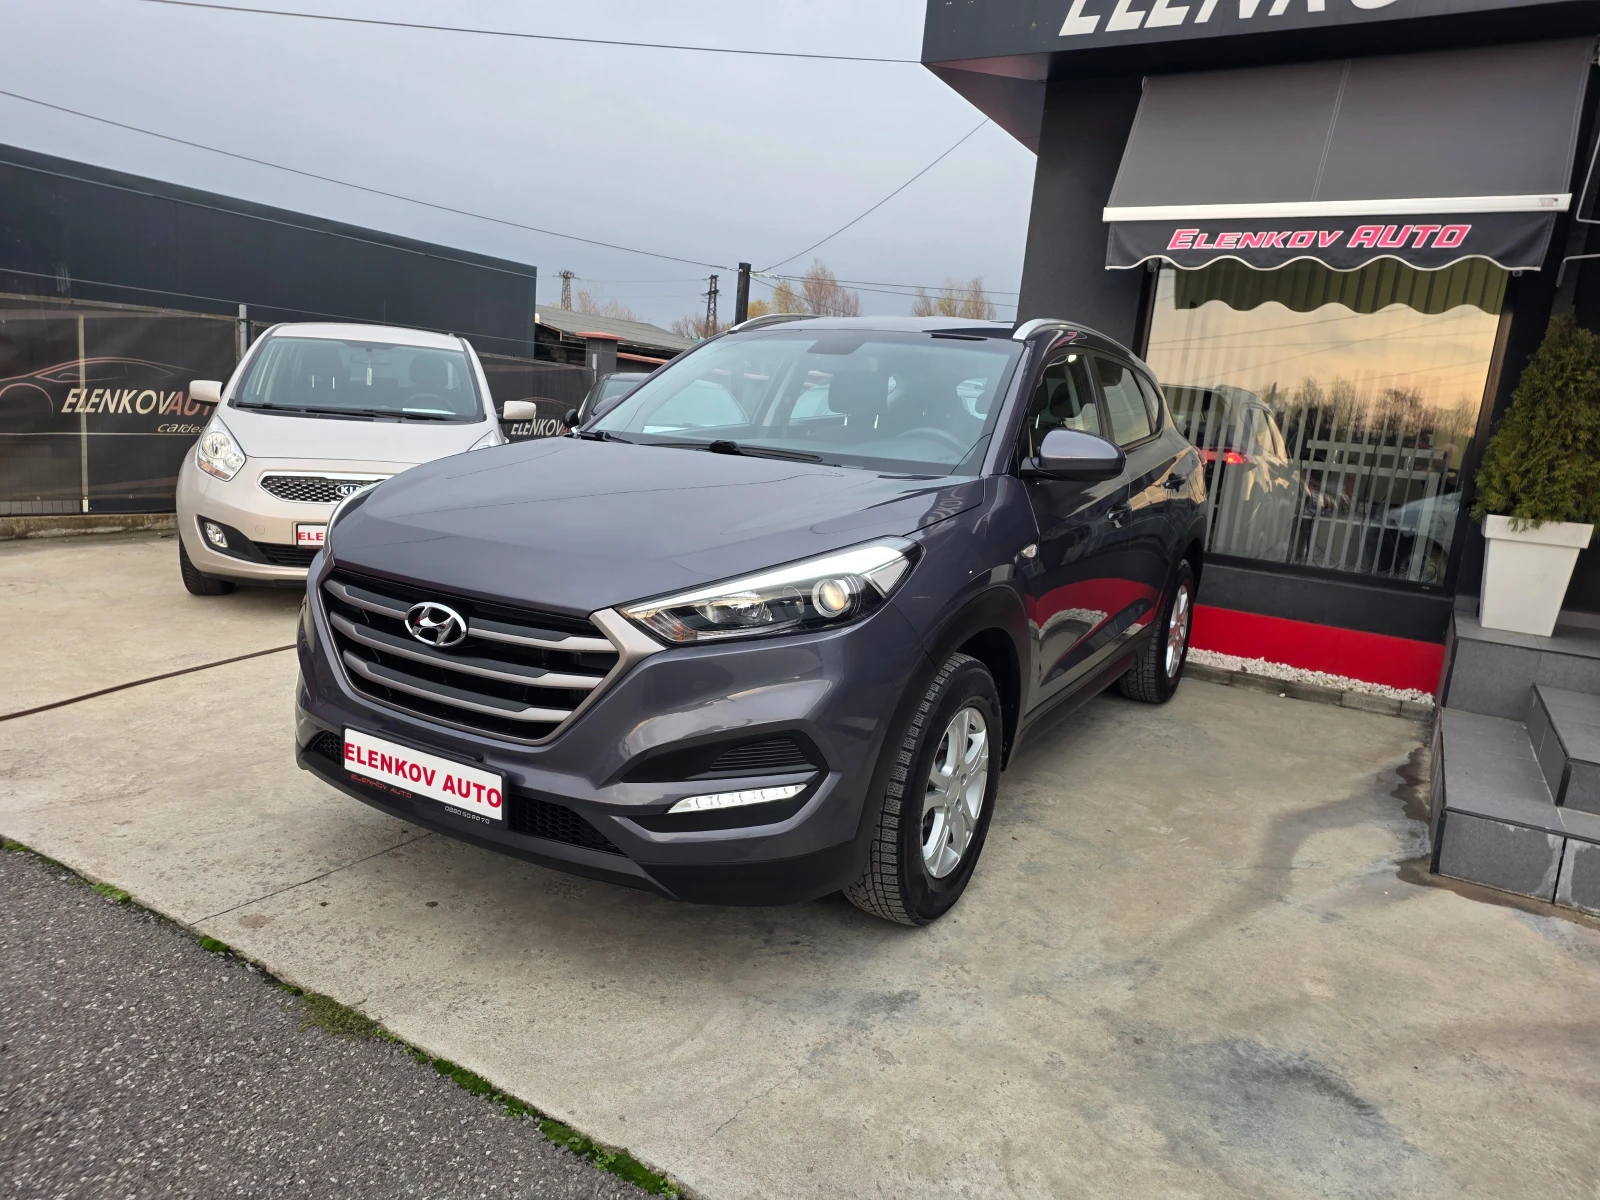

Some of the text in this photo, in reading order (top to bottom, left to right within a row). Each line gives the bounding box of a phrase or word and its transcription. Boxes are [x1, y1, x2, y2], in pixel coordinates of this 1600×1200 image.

[1166, 224, 1472, 250] ELENKOV AUTO
[341, 486, 361, 495] KI
[344, 741, 502, 808] ELENKOV AUTO
[390, 787, 412, 799] AUTO
